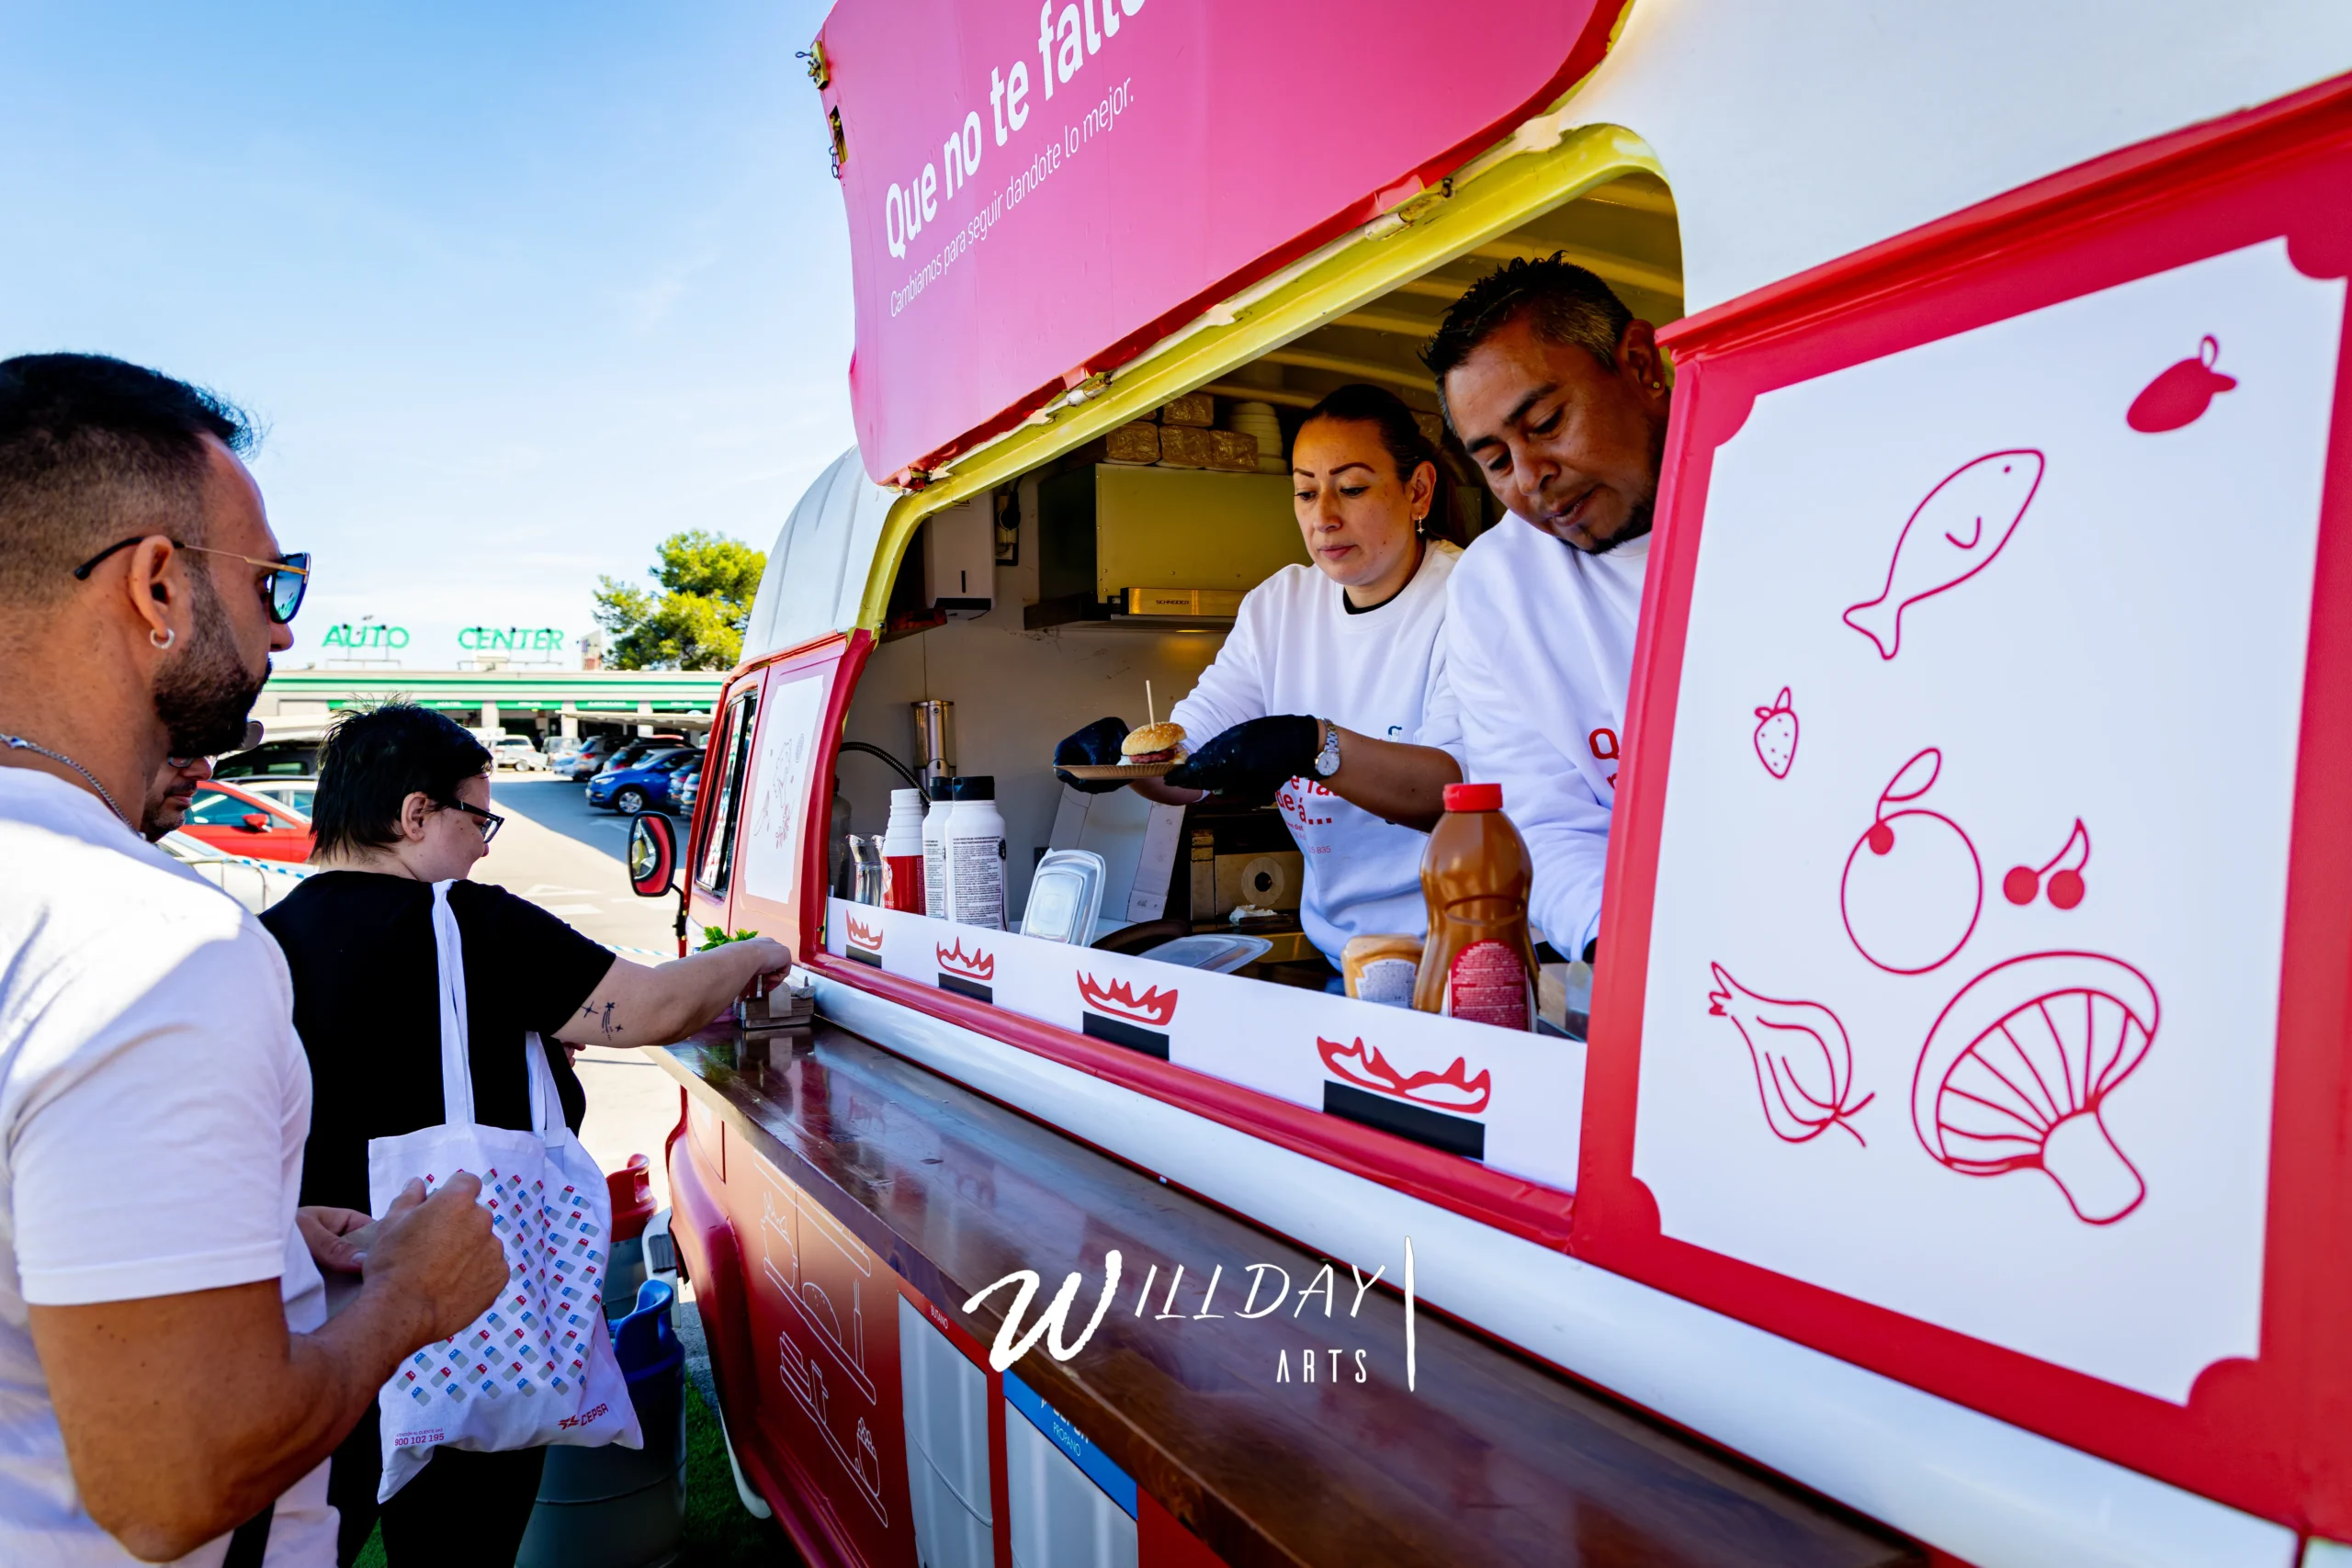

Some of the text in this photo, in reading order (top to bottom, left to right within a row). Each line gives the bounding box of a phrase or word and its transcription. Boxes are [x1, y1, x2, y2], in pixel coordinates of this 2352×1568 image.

[886, 0, 1146, 260] Que no te fal
[890, 77, 1134, 317] Cambiamos para seguir dandote lo mejor.
[322, 625, 564, 650] AUTO CENTER
[931, 1305, 948, 1329] BUTANO
[581, 1403, 609, 1426] CEPSA
[394, 1433, 445, 1446] 900 102 195
[1053, 1422, 1081, 1457] PROPANO
